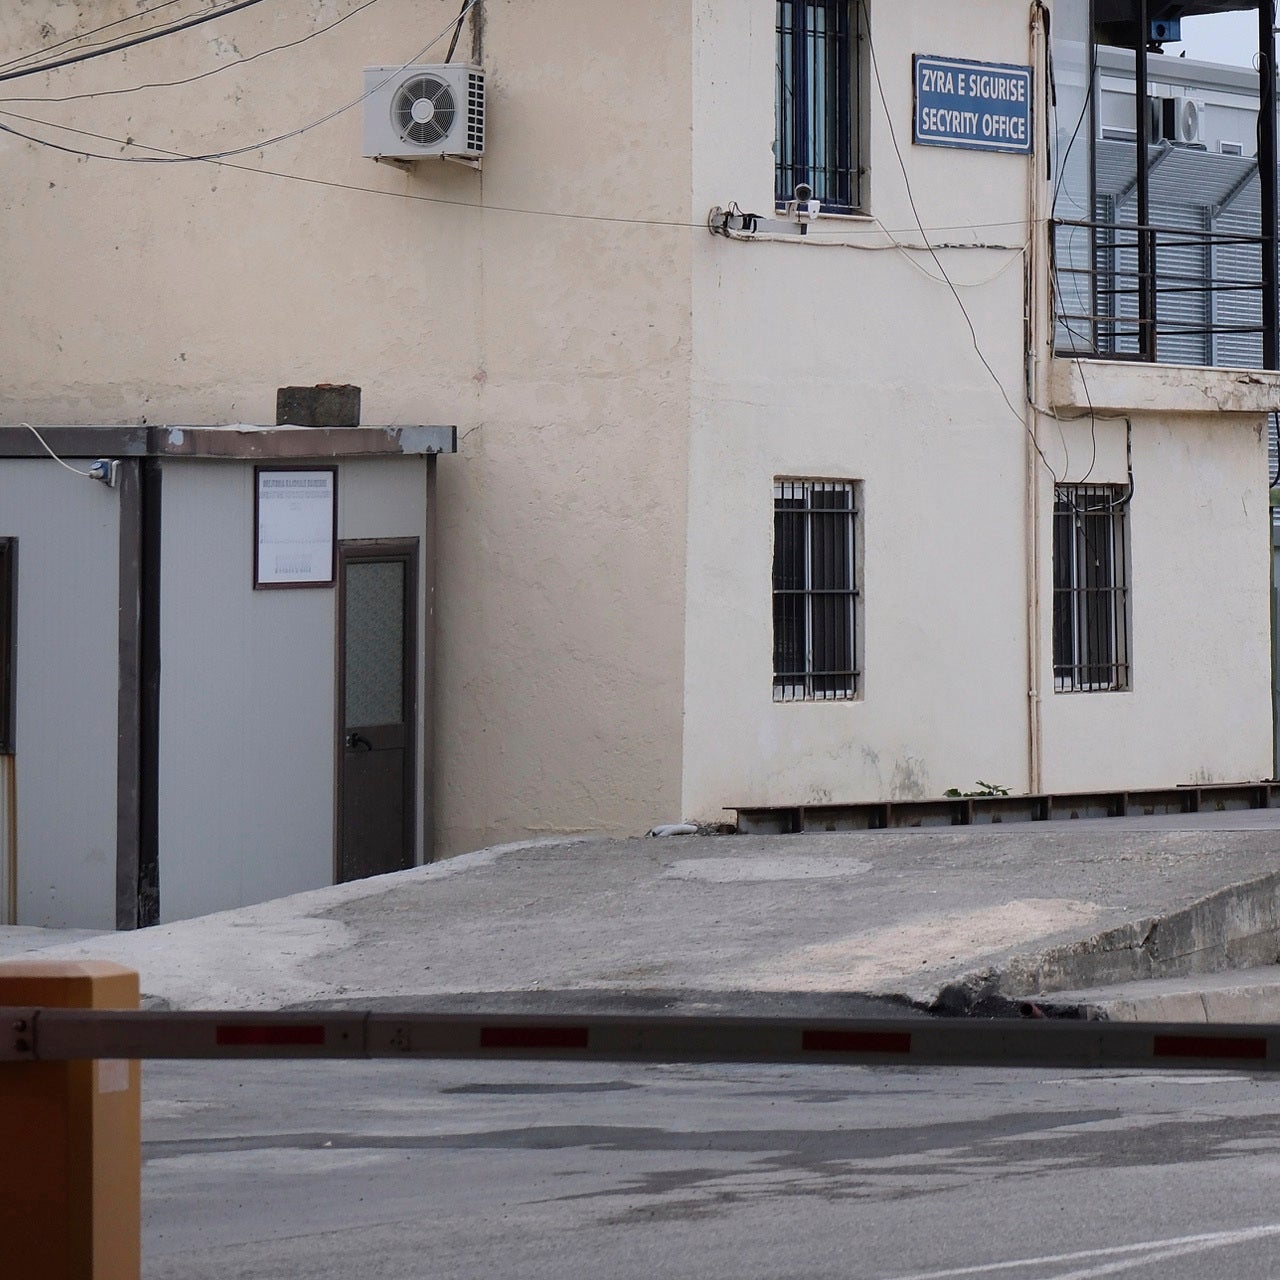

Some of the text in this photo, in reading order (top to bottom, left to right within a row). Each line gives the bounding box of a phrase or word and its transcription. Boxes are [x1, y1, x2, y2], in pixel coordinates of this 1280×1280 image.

[922, 69, 1025, 102] ZYRA E SIGURISE
[922, 107, 1025, 139] SECYRITY OFFICE
